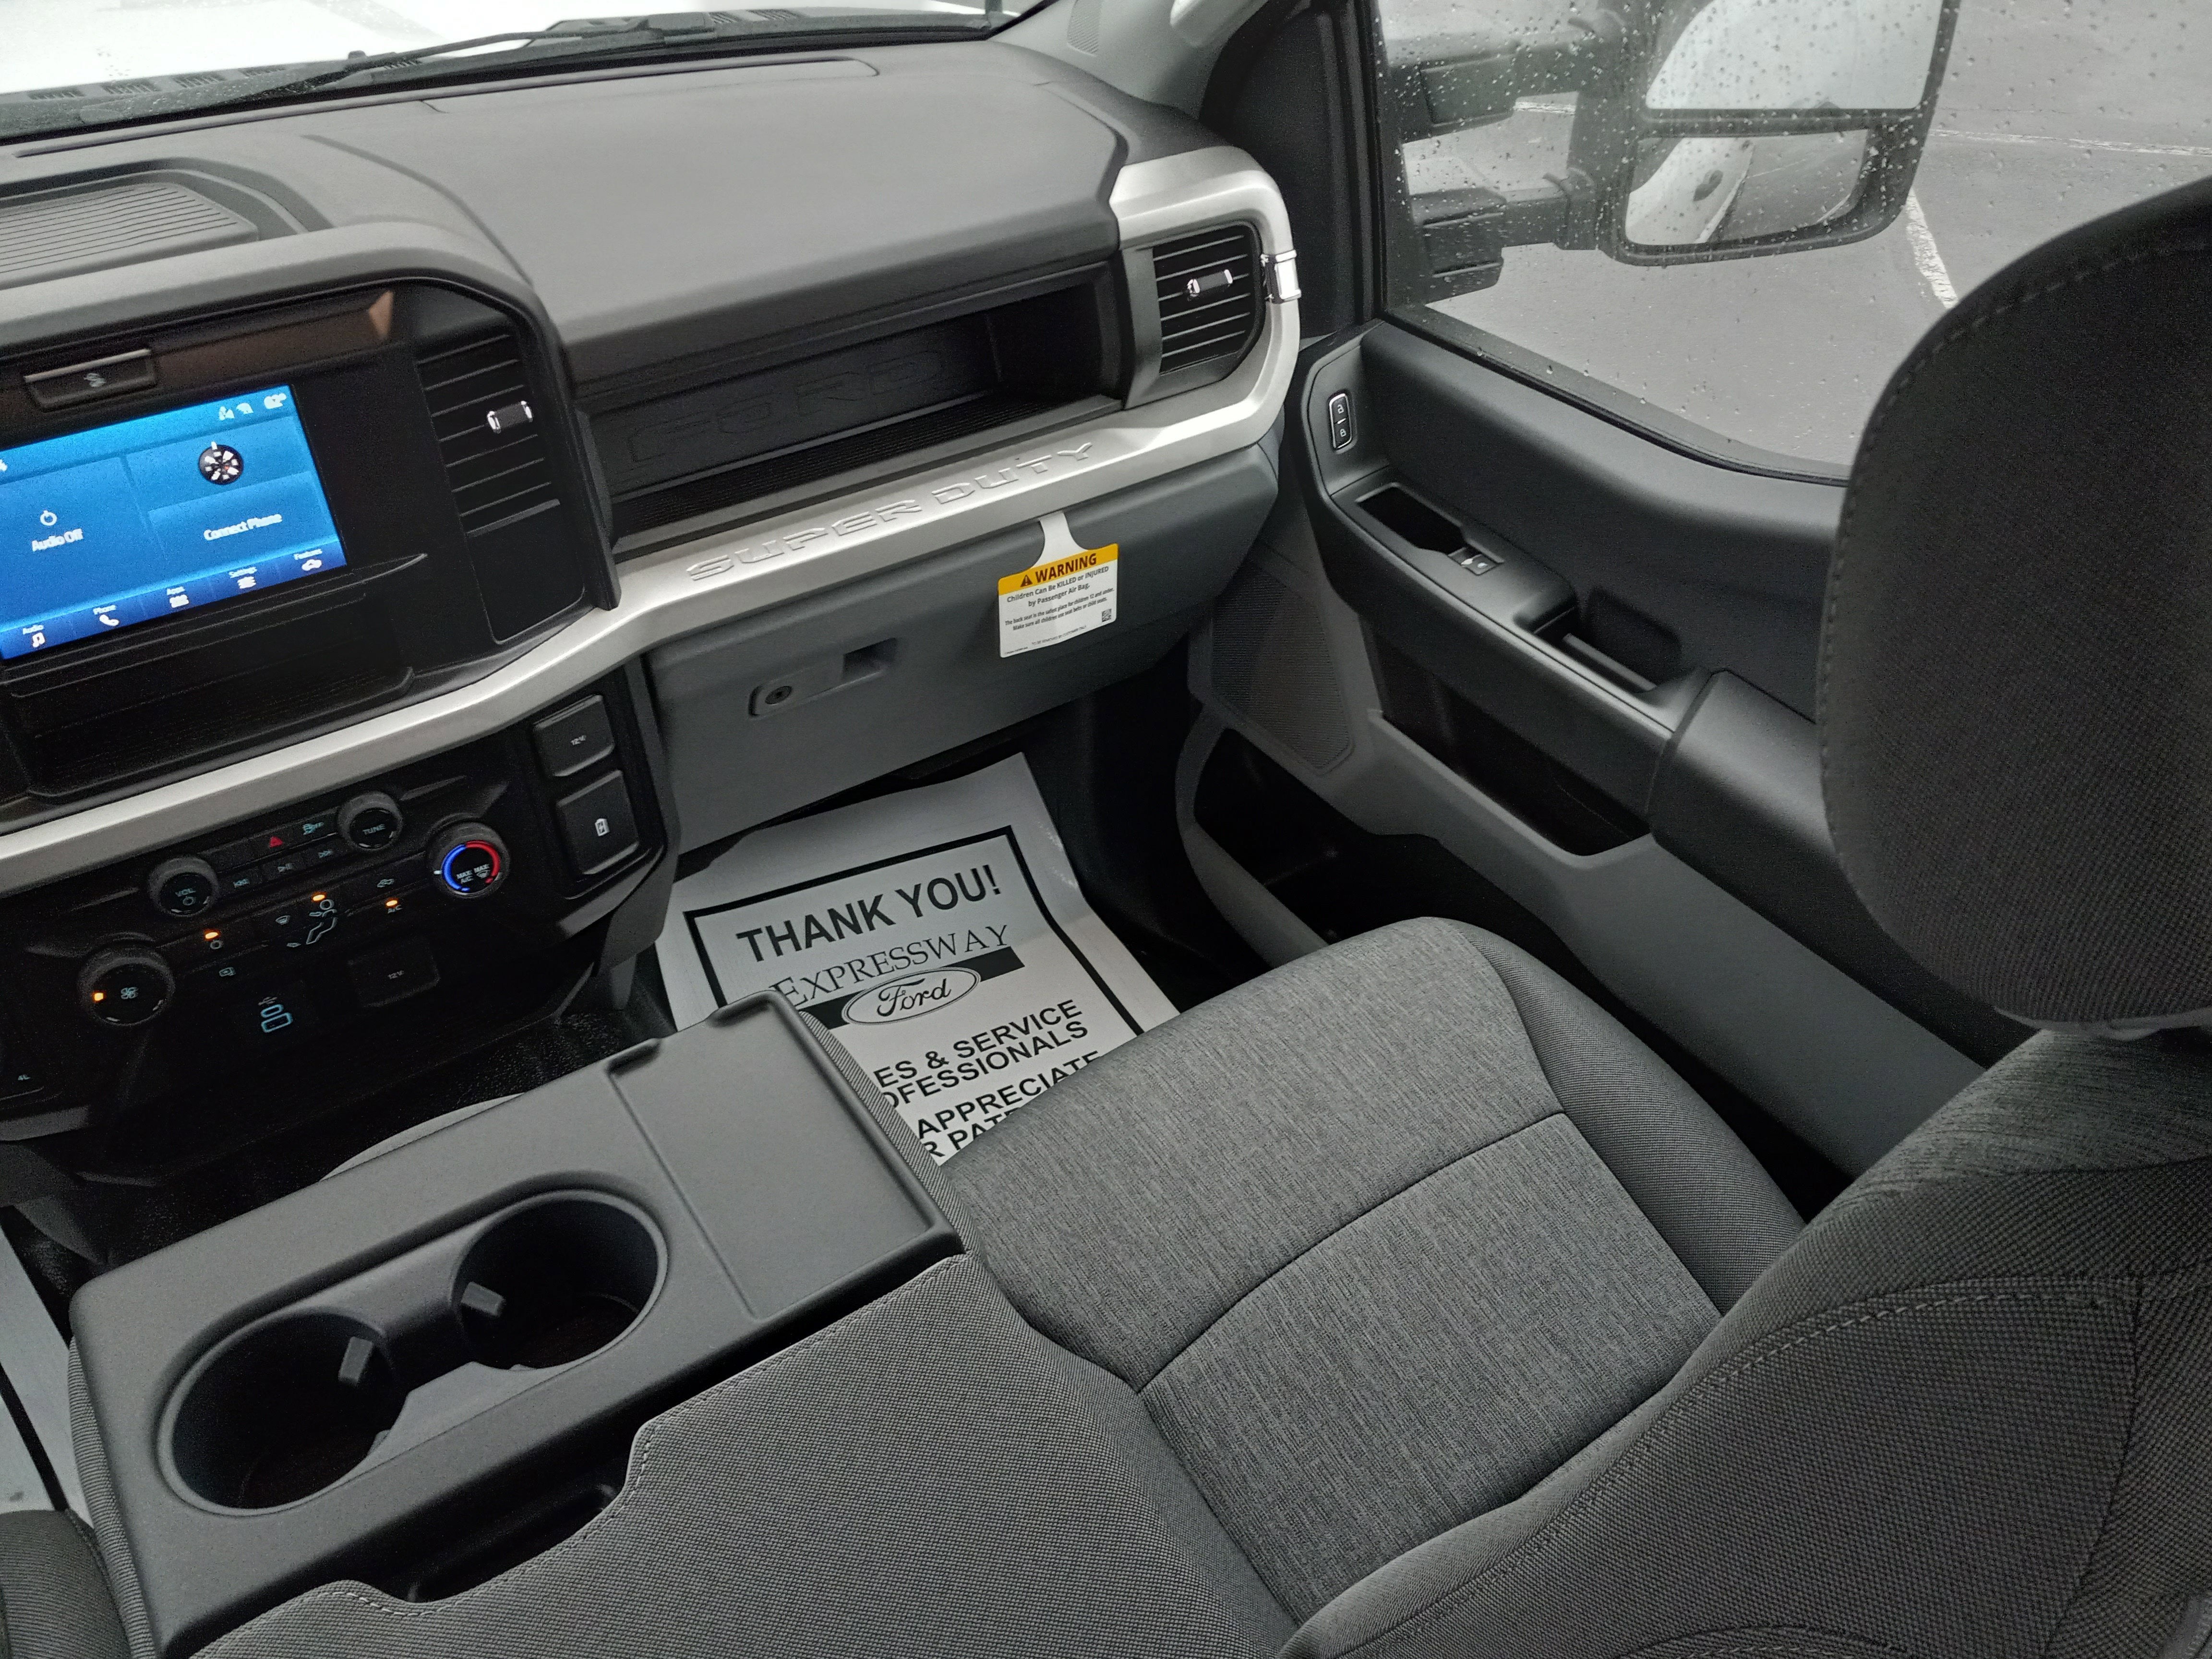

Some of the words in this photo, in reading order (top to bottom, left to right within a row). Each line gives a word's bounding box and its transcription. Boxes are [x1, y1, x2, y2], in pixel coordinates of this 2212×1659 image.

[685, 499, 922, 581] SUPER
[931, 442, 1092, 504] DUTY
[31, 535, 65, 552] Audio
[64, 528, 84, 543] Off
[204, 521, 249, 541] Connect
[247, 514, 283, 529] Phone
[1035, 553, 1097, 583] WARNING
[1007, 591, 1034, 602] Children
[1035, 587, 1047, 595] Can
[1057, 577, 1077, 589] KILLED
[1085, 566, 1109, 579] INJURED
[1037, 590, 1068, 604] Passenger
[1068, 587, 1077, 595] Air
[1078, 583, 1090, 591] Bag.
[1041, 615, 1058, 623] children
[1058, 604, 1067, 612] place
[362, 824, 386, 836] TUNE
[457, 870, 474, 880] MAX
[474, 864, 490, 873] MAX
[175, 889, 196, 897] VOL
[735, 893, 897, 962] THANK
[894, 864, 1002, 918] YOU!
[769, 925, 1008, 1009] EXPRESSWAY
[877, 978, 952, 1017] Ford
[873, 1060, 918, 1088] ES
[925, 1051, 950, 1069] &
[953, 999, 1082, 1058] SERVICE
